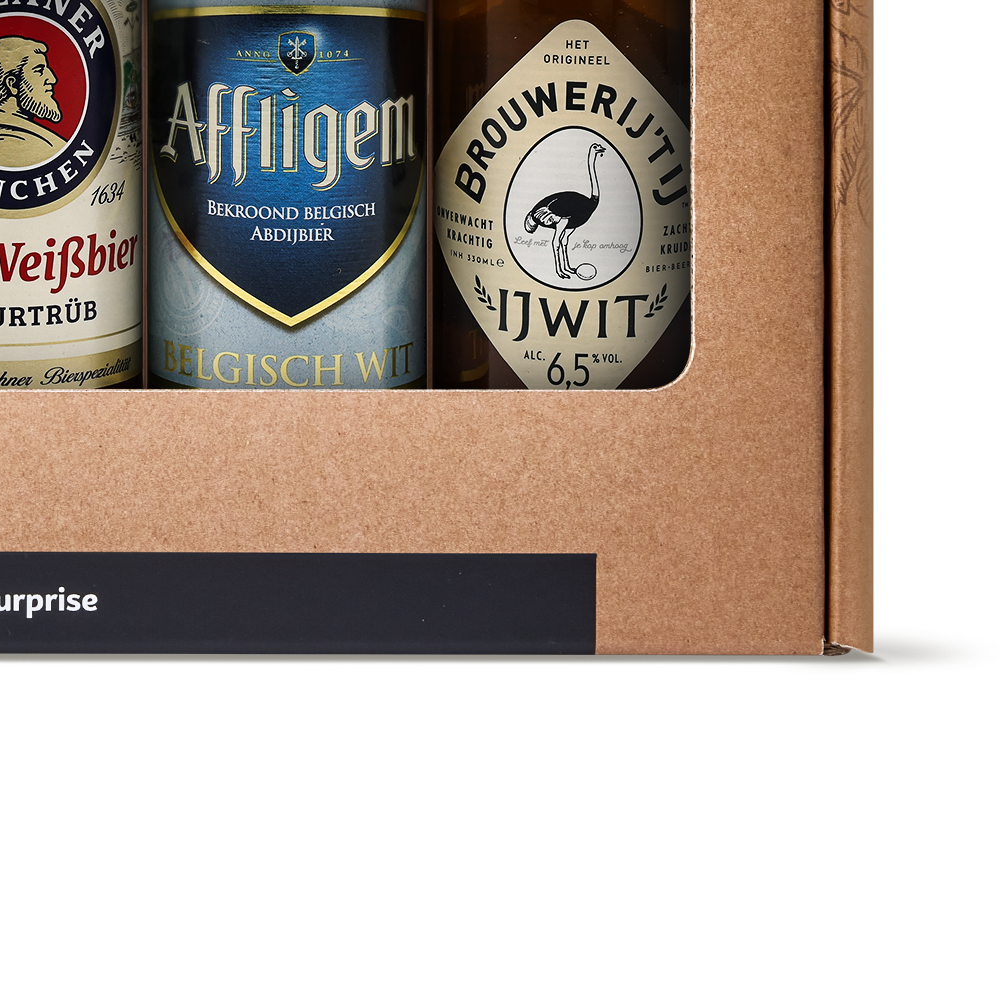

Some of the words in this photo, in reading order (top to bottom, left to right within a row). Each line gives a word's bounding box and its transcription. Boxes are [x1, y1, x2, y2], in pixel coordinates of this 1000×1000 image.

[236, 50, 271, 58] ANNO
[319, 50, 350, 58] 1074
[566, 40, 590, 50] HET
[543, 54, 610, 65] ORIGINEEL
[159, 80, 418, 192] Affligem
[89, 179, 126, 208] 1634
[207, 199, 299, 220] BEKROOND
[304, 202, 376, 220] BELGISCH
[437, 205, 493, 231] ONVERWACHT
[250, 226, 334, 245] ABDIJBIER
[446, 228, 493, 249] KRACHTIG
[534, 239, 549, 247] met
[450, 249, 463, 259] INH
[660, 240, 691, 255] KRUID
[498, 288, 649, 341] IJWIT
[40, 356, 132, 386] Bierspezialität
[163, 339, 345, 389] BELGISCH
[354, 341, 414, 383] WIT
[523, 350, 546, 361] ALC.
[547, 352, 590, 389] 6,5
[602, 353, 622, 363] VOL.
